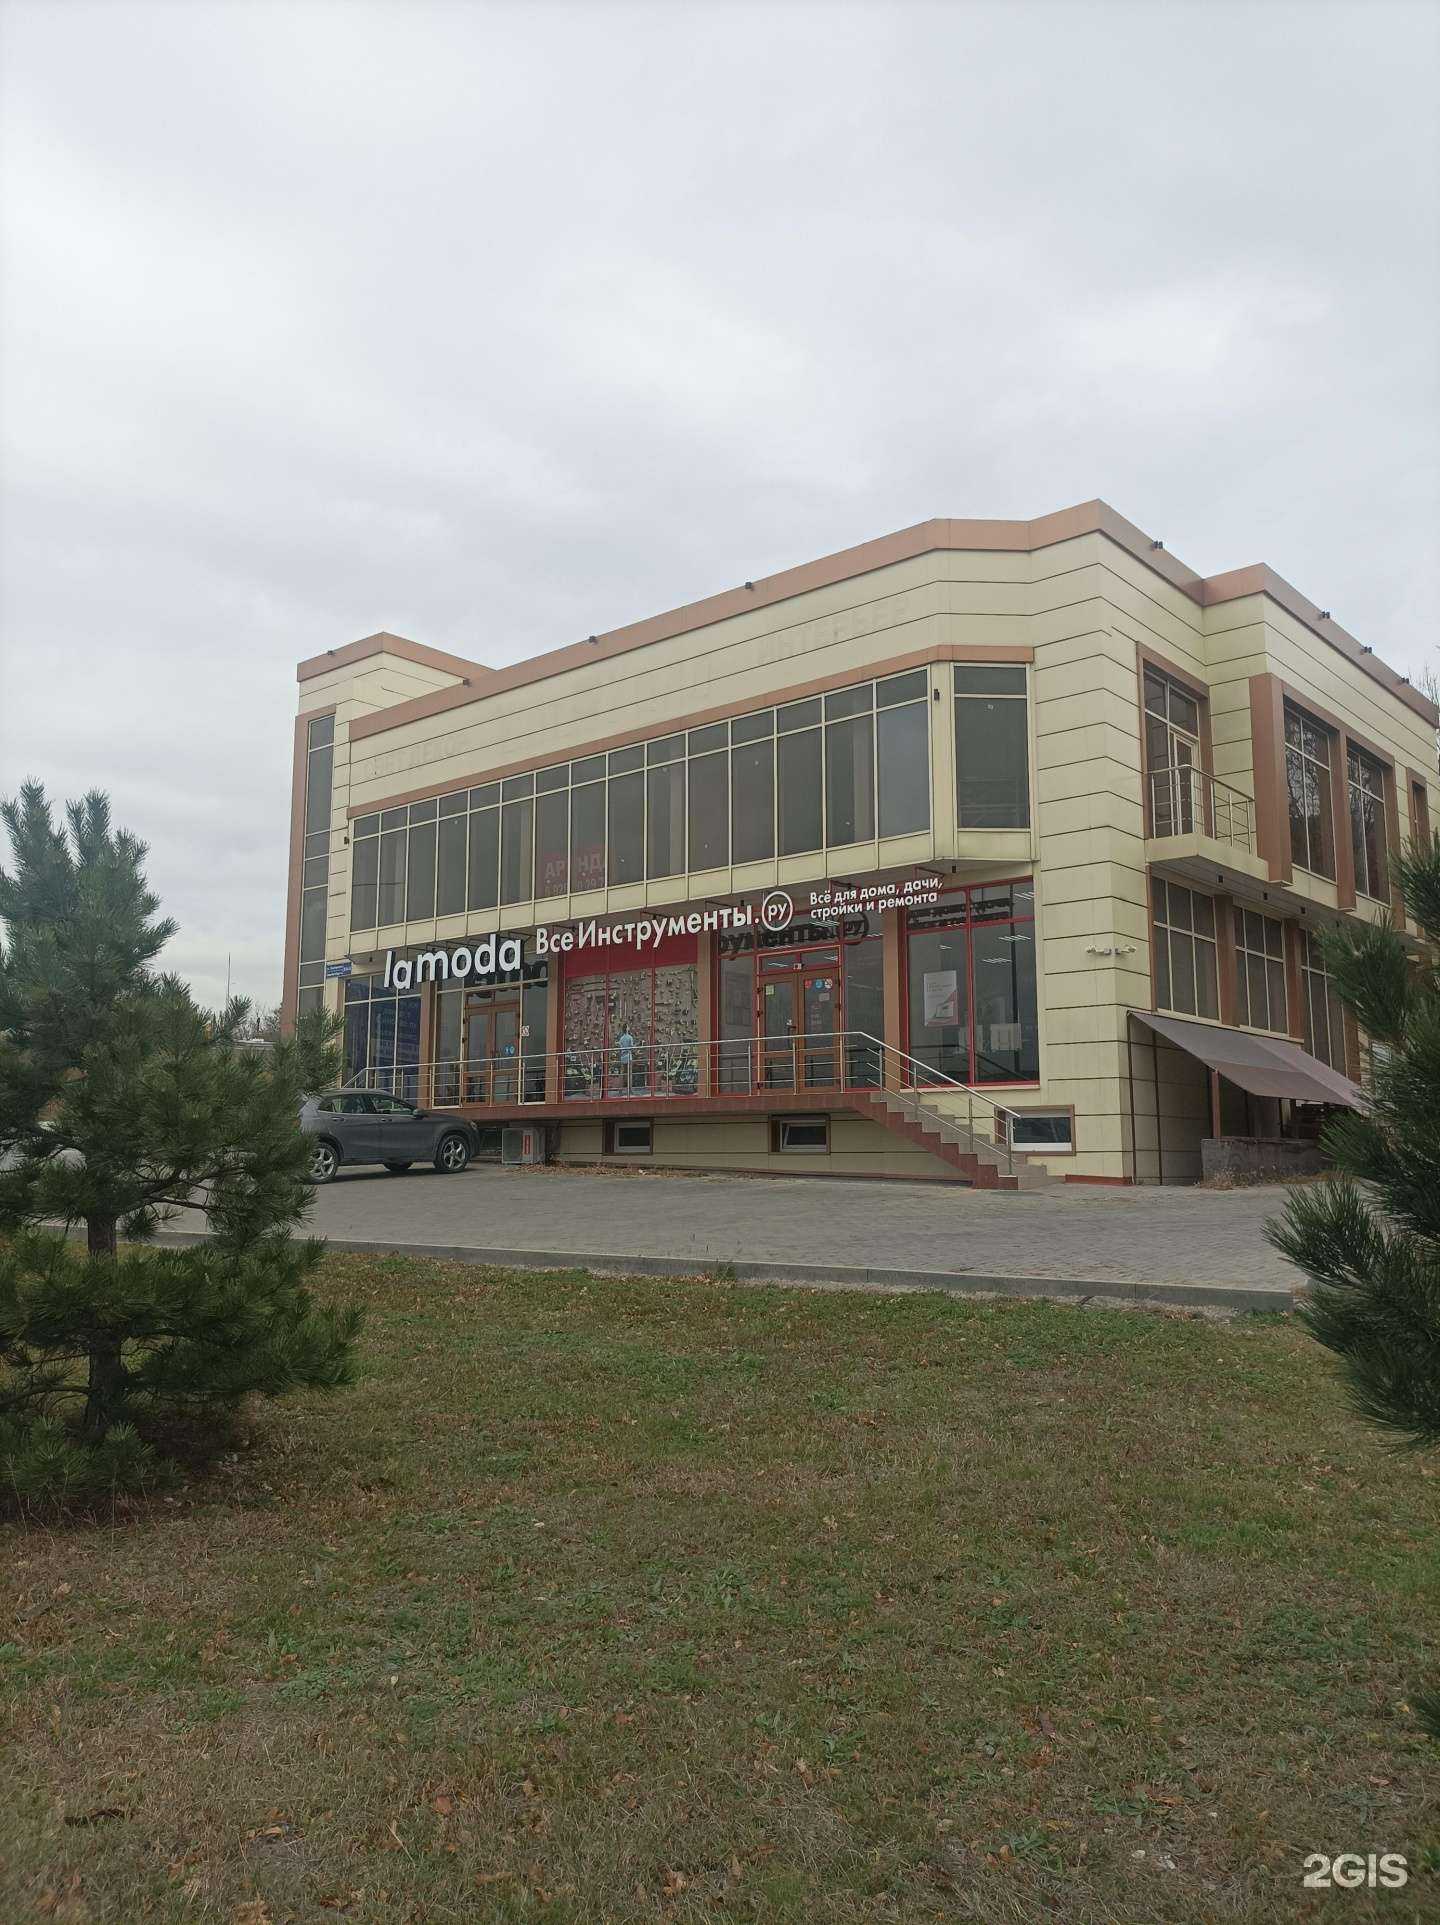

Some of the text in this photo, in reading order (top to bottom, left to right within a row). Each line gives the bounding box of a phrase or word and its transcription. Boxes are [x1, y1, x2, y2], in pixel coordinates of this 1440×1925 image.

[810, 878, 943, 906] Всё для дома, дачи,
[810, 892, 938, 920] стройки и ремонта
[383, 933, 522, 990] lamoda
